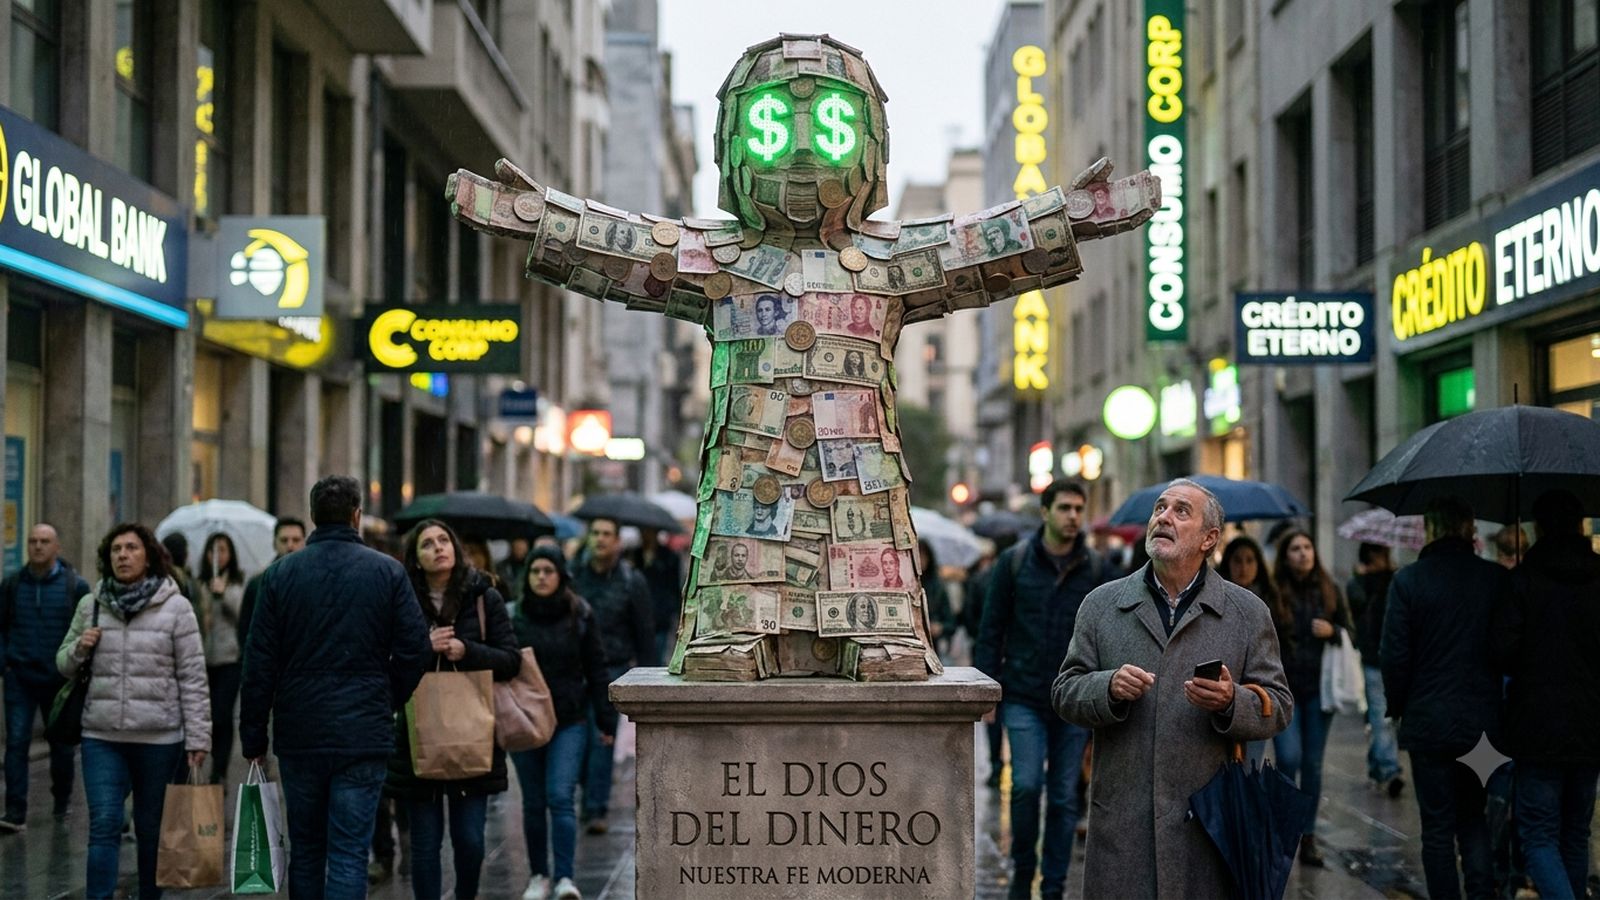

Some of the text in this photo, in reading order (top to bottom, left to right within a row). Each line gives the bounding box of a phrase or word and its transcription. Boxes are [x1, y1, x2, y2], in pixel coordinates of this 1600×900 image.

[1147, 15, 1184, 331] CONSUMO CORP
[13, 150, 167, 284] GLOBAL BANK
[1013, 45, 1049, 390] GLOBA ANK
[1392, 188, 1600, 341] CRÉDITO ETERNO
[1241, 296, 1365, 329] CRÉDITO
[1247, 329, 1361, 357] ETERNO
[720, 761, 888, 797] EL DIOS
[669, 810, 941, 847] DEL DINERO
[679, 866, 932, 885] NUESTRA FE MODERNA
